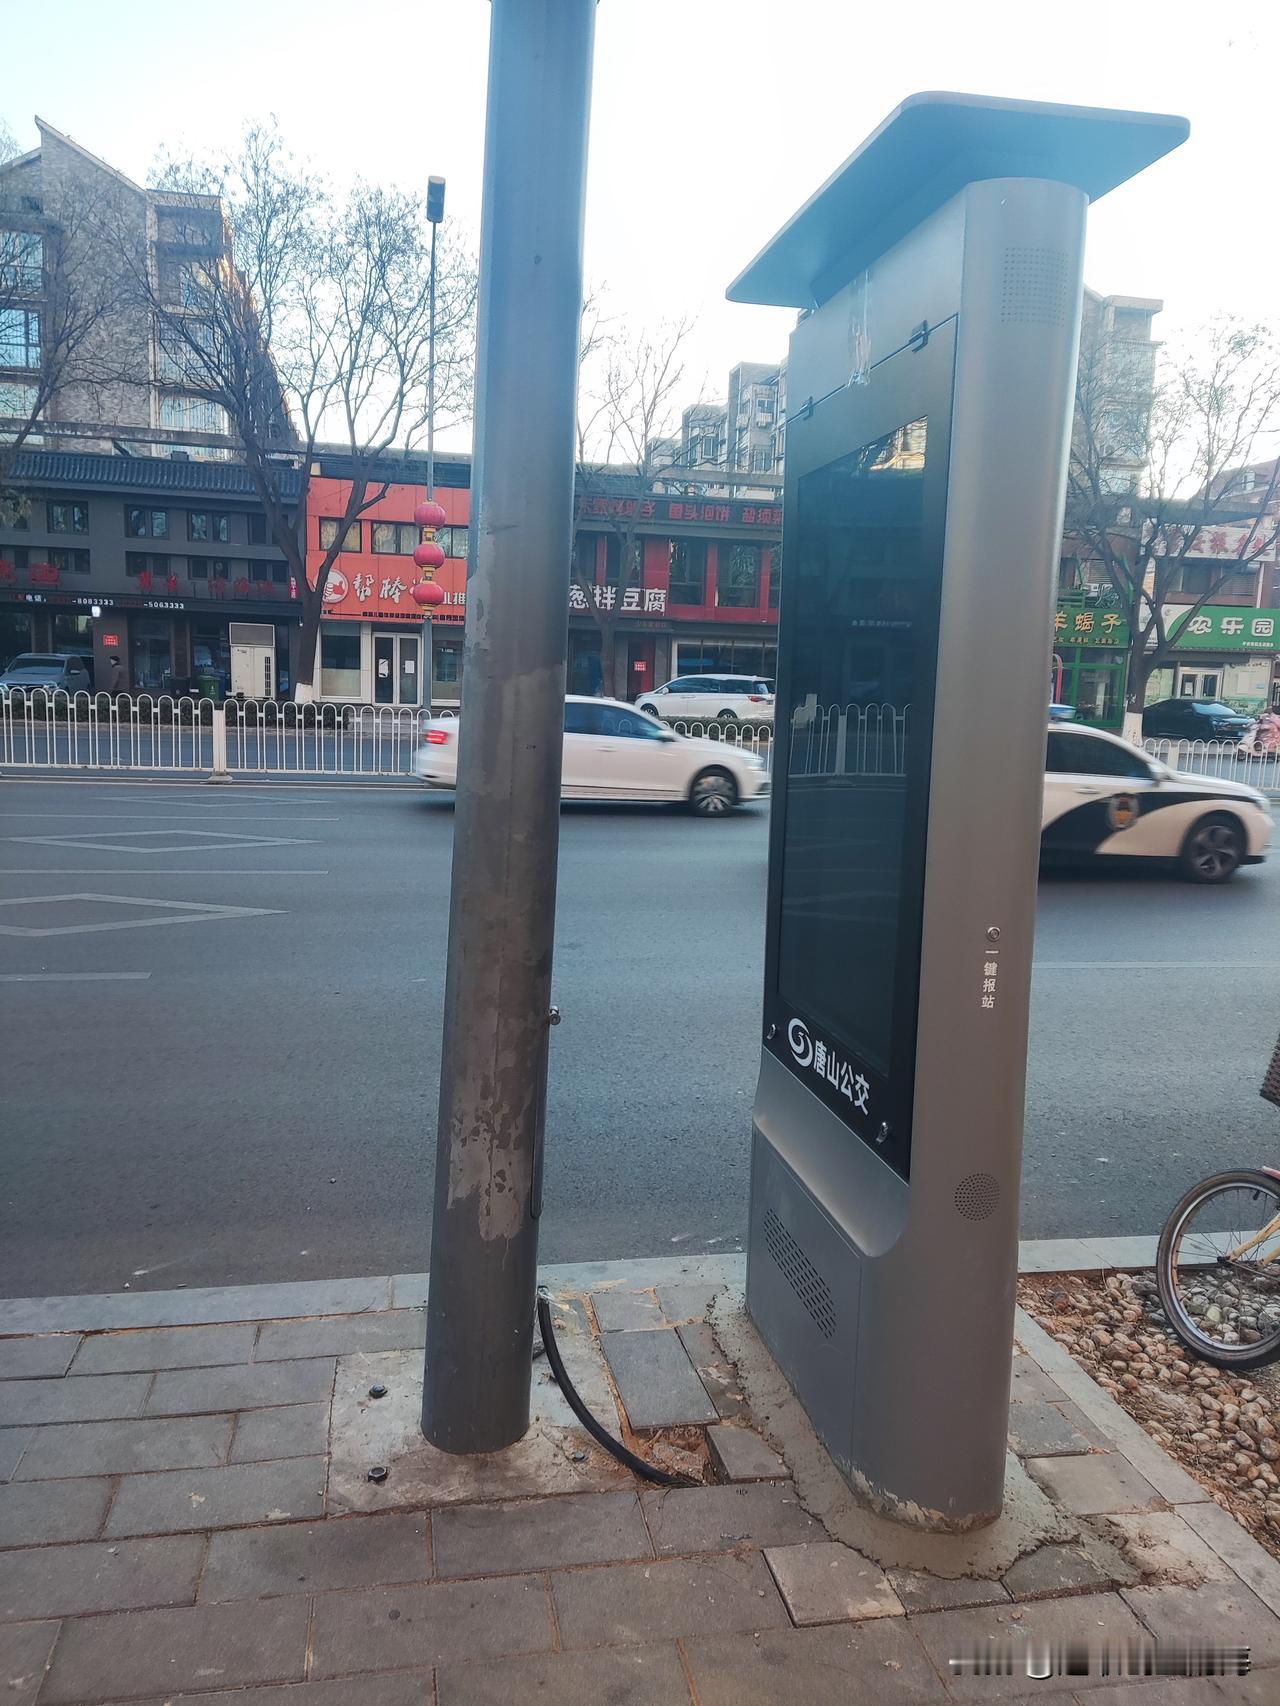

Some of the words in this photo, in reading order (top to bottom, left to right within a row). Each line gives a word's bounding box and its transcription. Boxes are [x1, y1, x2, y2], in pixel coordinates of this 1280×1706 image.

[568, 584, 668, 613] 葱拌豆腐
[1055, 611, 1122, 634] 羊蝎子
[981, 950, 1000, 1009] 一键报站
[813, 1039, 871, 1116] 唐山公交
